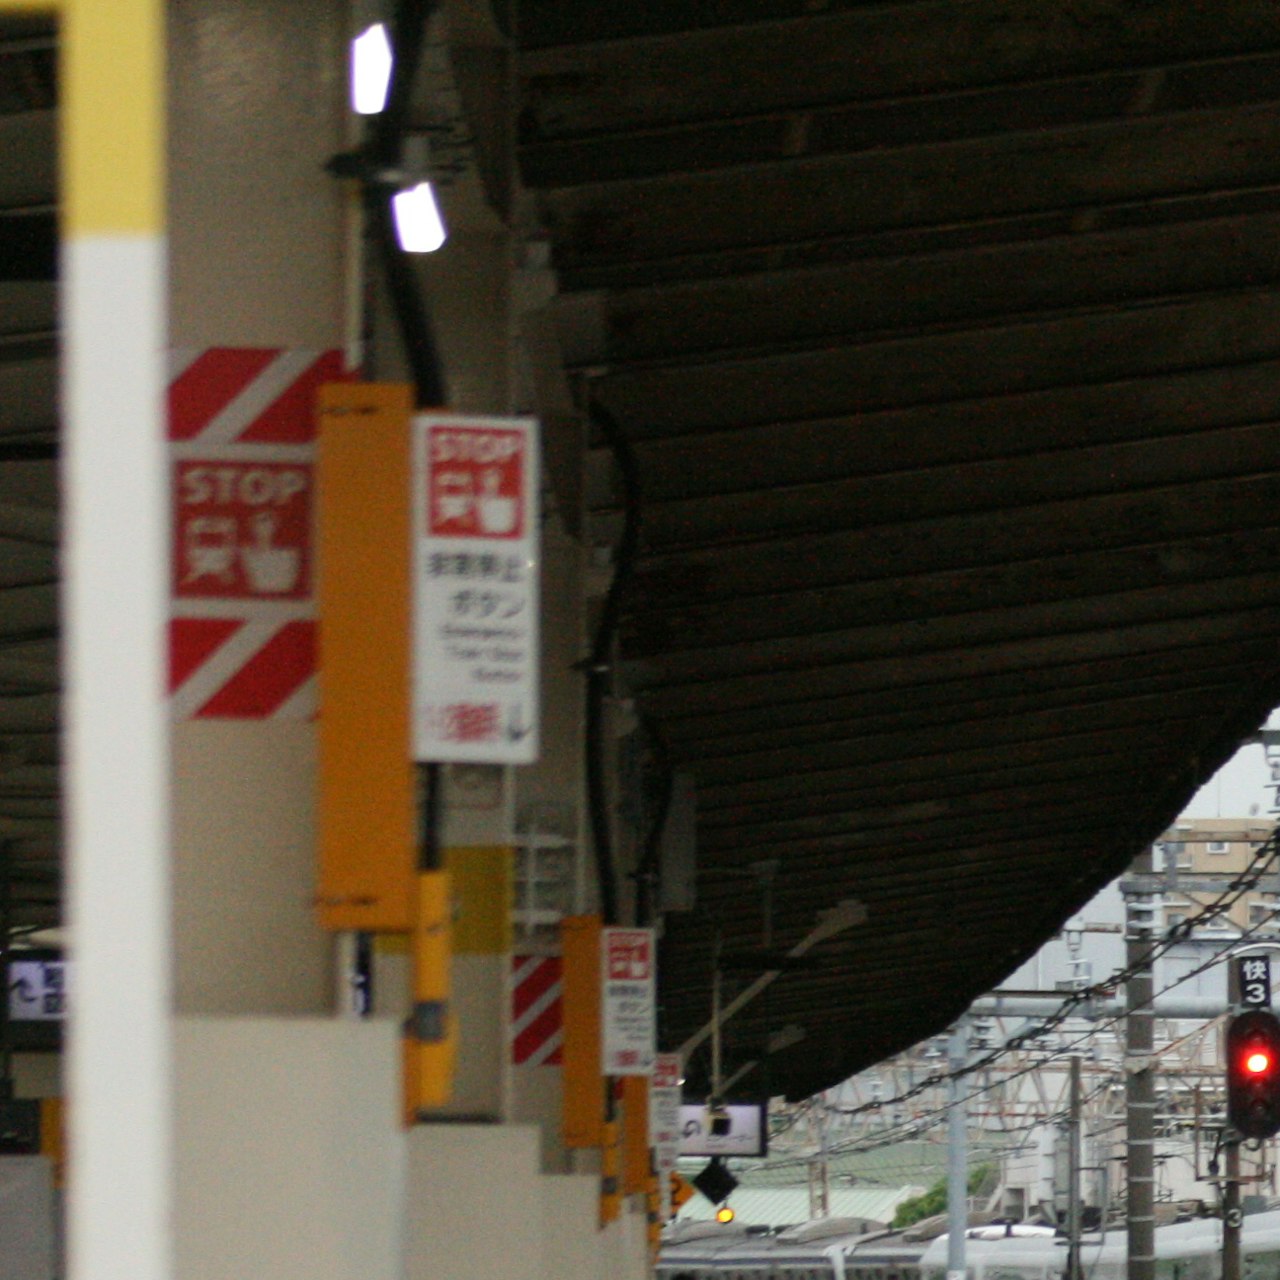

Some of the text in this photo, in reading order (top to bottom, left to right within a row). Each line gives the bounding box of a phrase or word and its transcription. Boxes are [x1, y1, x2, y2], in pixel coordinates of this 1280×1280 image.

[432, 432, 518, 463] STOP
[183, 467, 306, 506] STOP
[1227, 1208, 1242, 1228] 3
